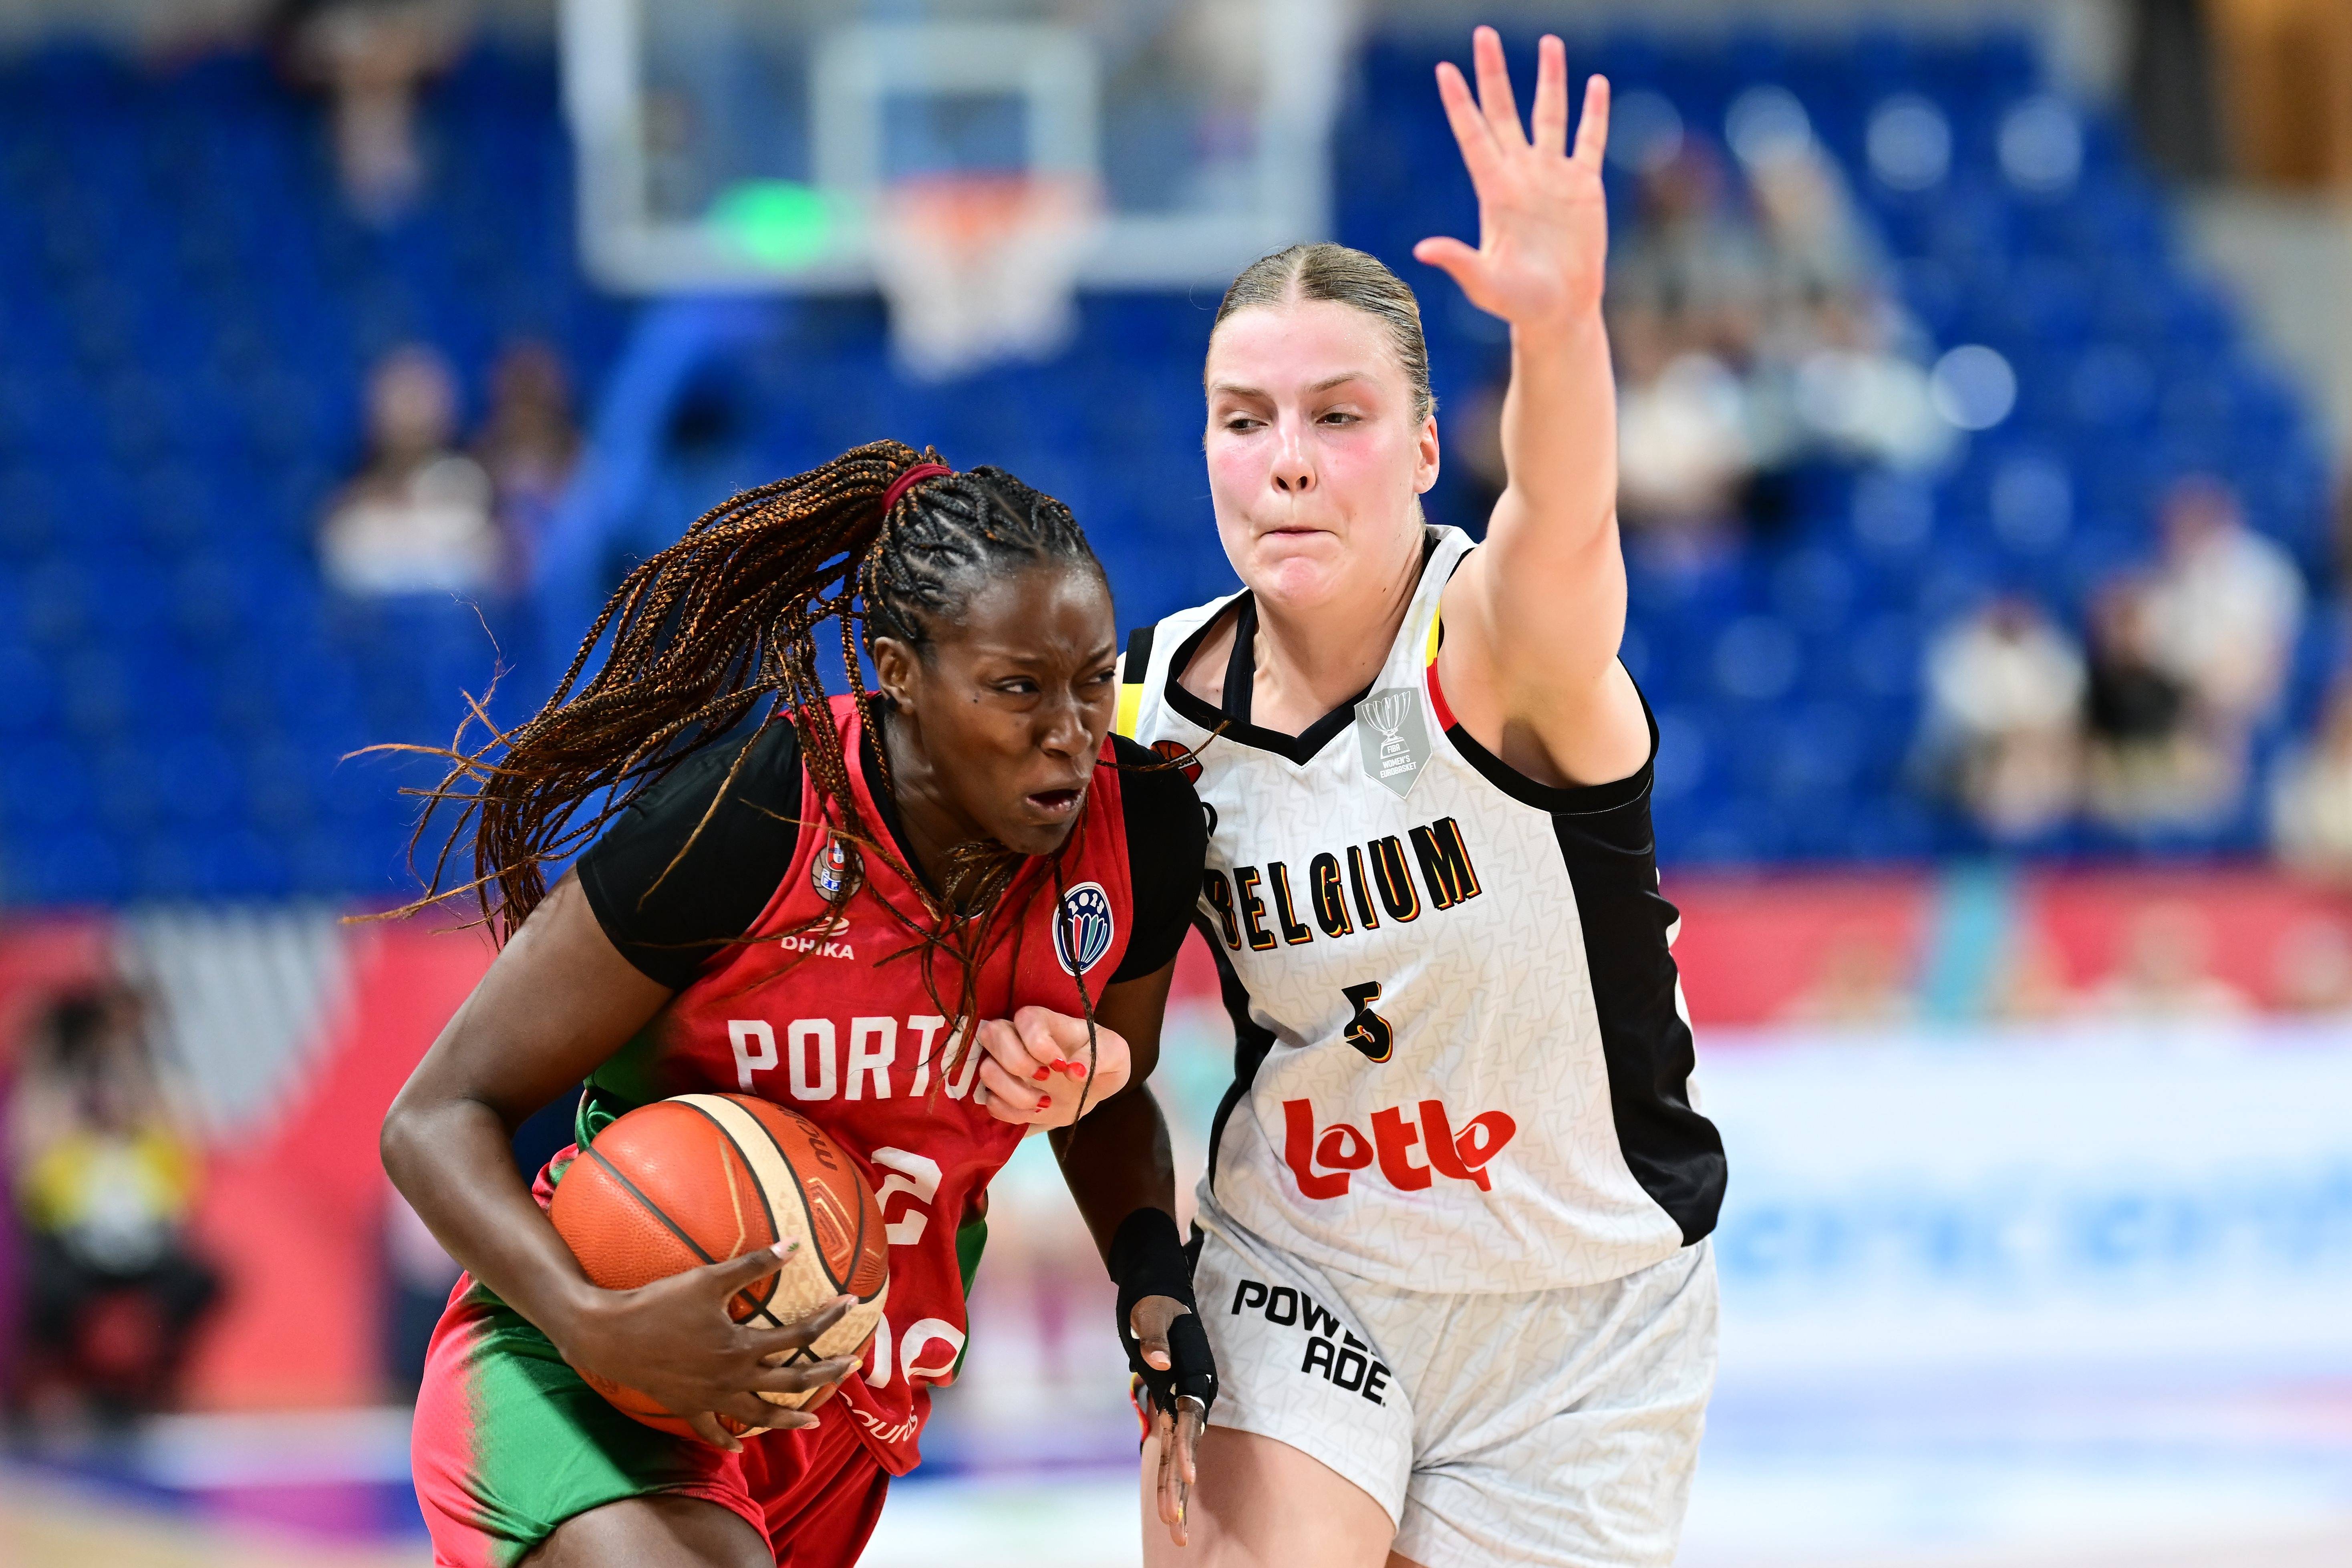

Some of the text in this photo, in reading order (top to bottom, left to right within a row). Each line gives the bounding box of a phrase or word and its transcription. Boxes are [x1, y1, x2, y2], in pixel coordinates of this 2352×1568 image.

[1380, 761, 1416, 778] EUROBASKET
[1382, 755, 1410, 769] WOMEN'S
[1387, 743, 1401, 754] FIBA
[1204, 817, 1482, 952] BELGIUM
[781, 936, 855, 960] DHIKA
[1341, 981, 1393, 1064] 5
[727, 1015, 989, 1105] PORTU
[1301, 1337, 1391, 1405] ADE
